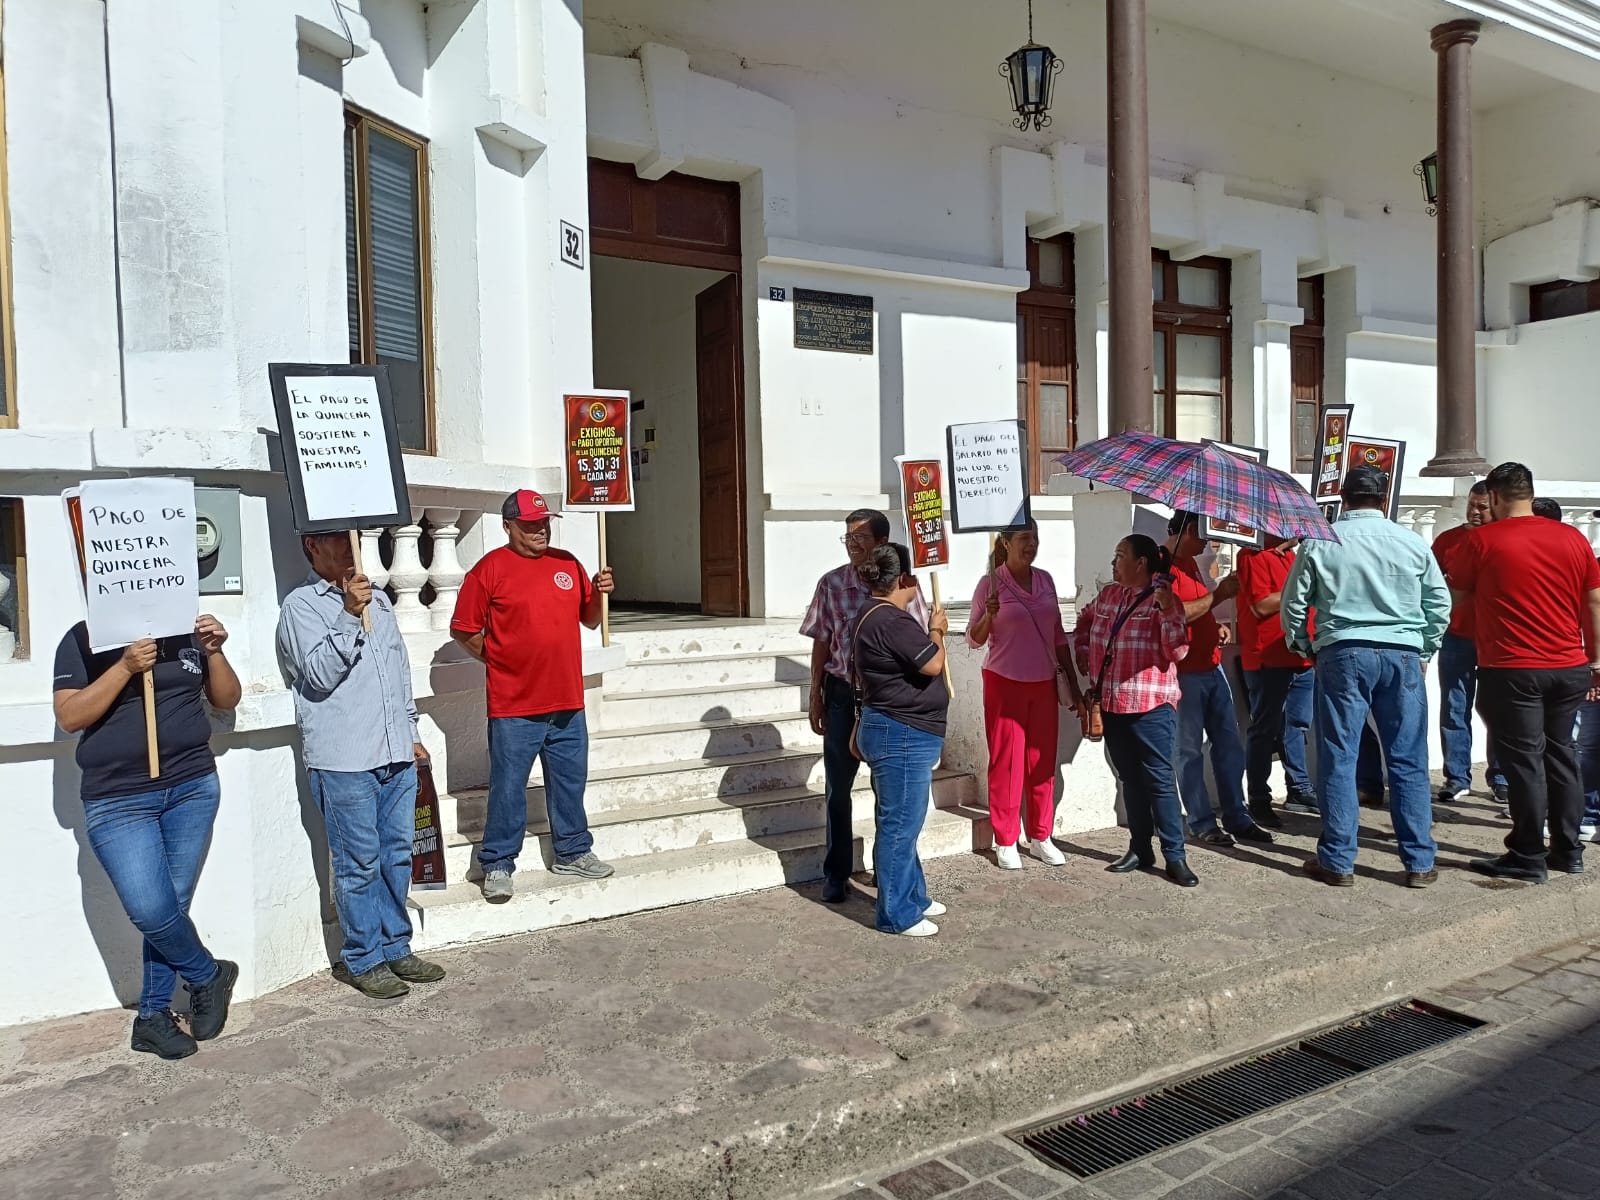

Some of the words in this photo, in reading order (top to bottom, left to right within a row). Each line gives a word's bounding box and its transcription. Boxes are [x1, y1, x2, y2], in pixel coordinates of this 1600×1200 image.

[565, 228, 580, 261] 32
[772, 289, 783, 300] 32
[291, 389, 312, 404] EL
[320, 394, 348, 404] PAGO
[354, 396, 369, 404] DE
[296, 411, 309, 419] LA
[314, 410, 371, 420] QUINCENA
[298, 430, 357, 441] SOSTIENE
[363, 430, 371, 438] A
[581, 427, 615, 438] EXIGIMOS
[577, 439, 594, 448] PAGO
[595, 437, 623, 446] OPORTUNO
[300, 445, 361, 456] NUESTRAS
[590, 447, 620, 457] QUINCENAS
[955, 450, 992, 461] SALARIO
[996, 447, 1008, 456] NO
[304, 460, 368, 472] FAMILIAS!
[578, 459, 591, 472] 15,
[593, 457, 605, 471] 30
[610, 456, 620, 470] 31
[956, 465, 968, 473] UN
[997, 464, 1010, 472] ES
[586, 471, 604, 482] CADA
[604, 470, 617, 480] MES
[957, 475, 1000, 485] NUESTRO
[914, 489, 937, 502] EXIGIMOS
[959, 486, 1007, 499] DERECHO!
[88, 505, 145, 527] PAGO
[161, 508, 186, 520] DE
[925, 519, 933, 533] 30
[91, 535, 169, 554] NUESTRA
[92, 556, 176, 576] QUINCENA
[98, 583, 110, 595] A
[111, 574, 185, 594] TIEMPO
